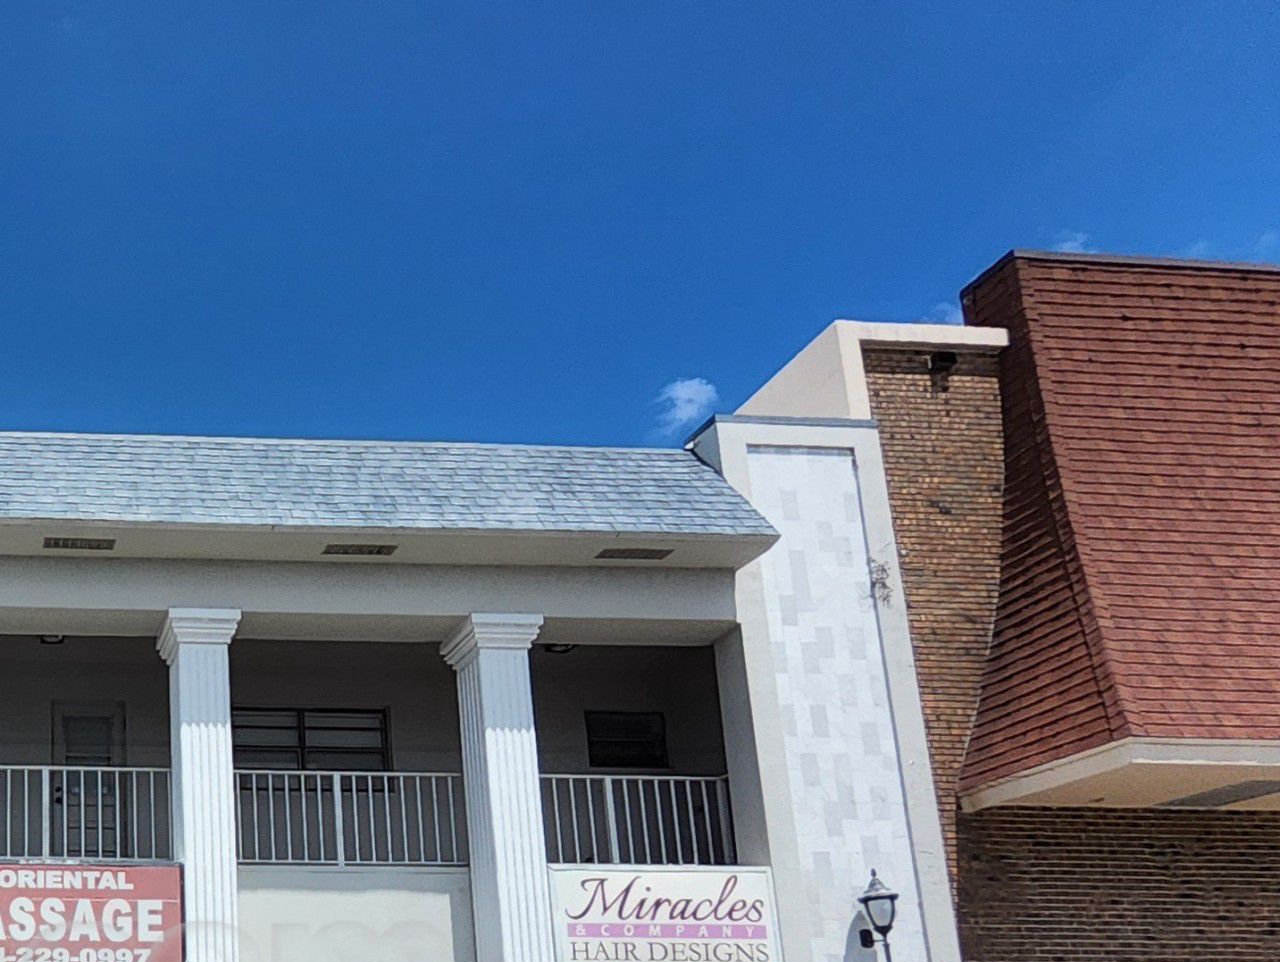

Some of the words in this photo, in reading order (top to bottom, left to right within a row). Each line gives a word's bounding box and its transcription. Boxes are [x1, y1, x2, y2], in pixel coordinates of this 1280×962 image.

[564, 874, 765, 923] Miracles
[575, 924, 587, 937] &
[600, 924, 756, 938] COMPANY
[570, 941, 641, 962] HAIR
[648, 943, 770, 962] DESIGNS
